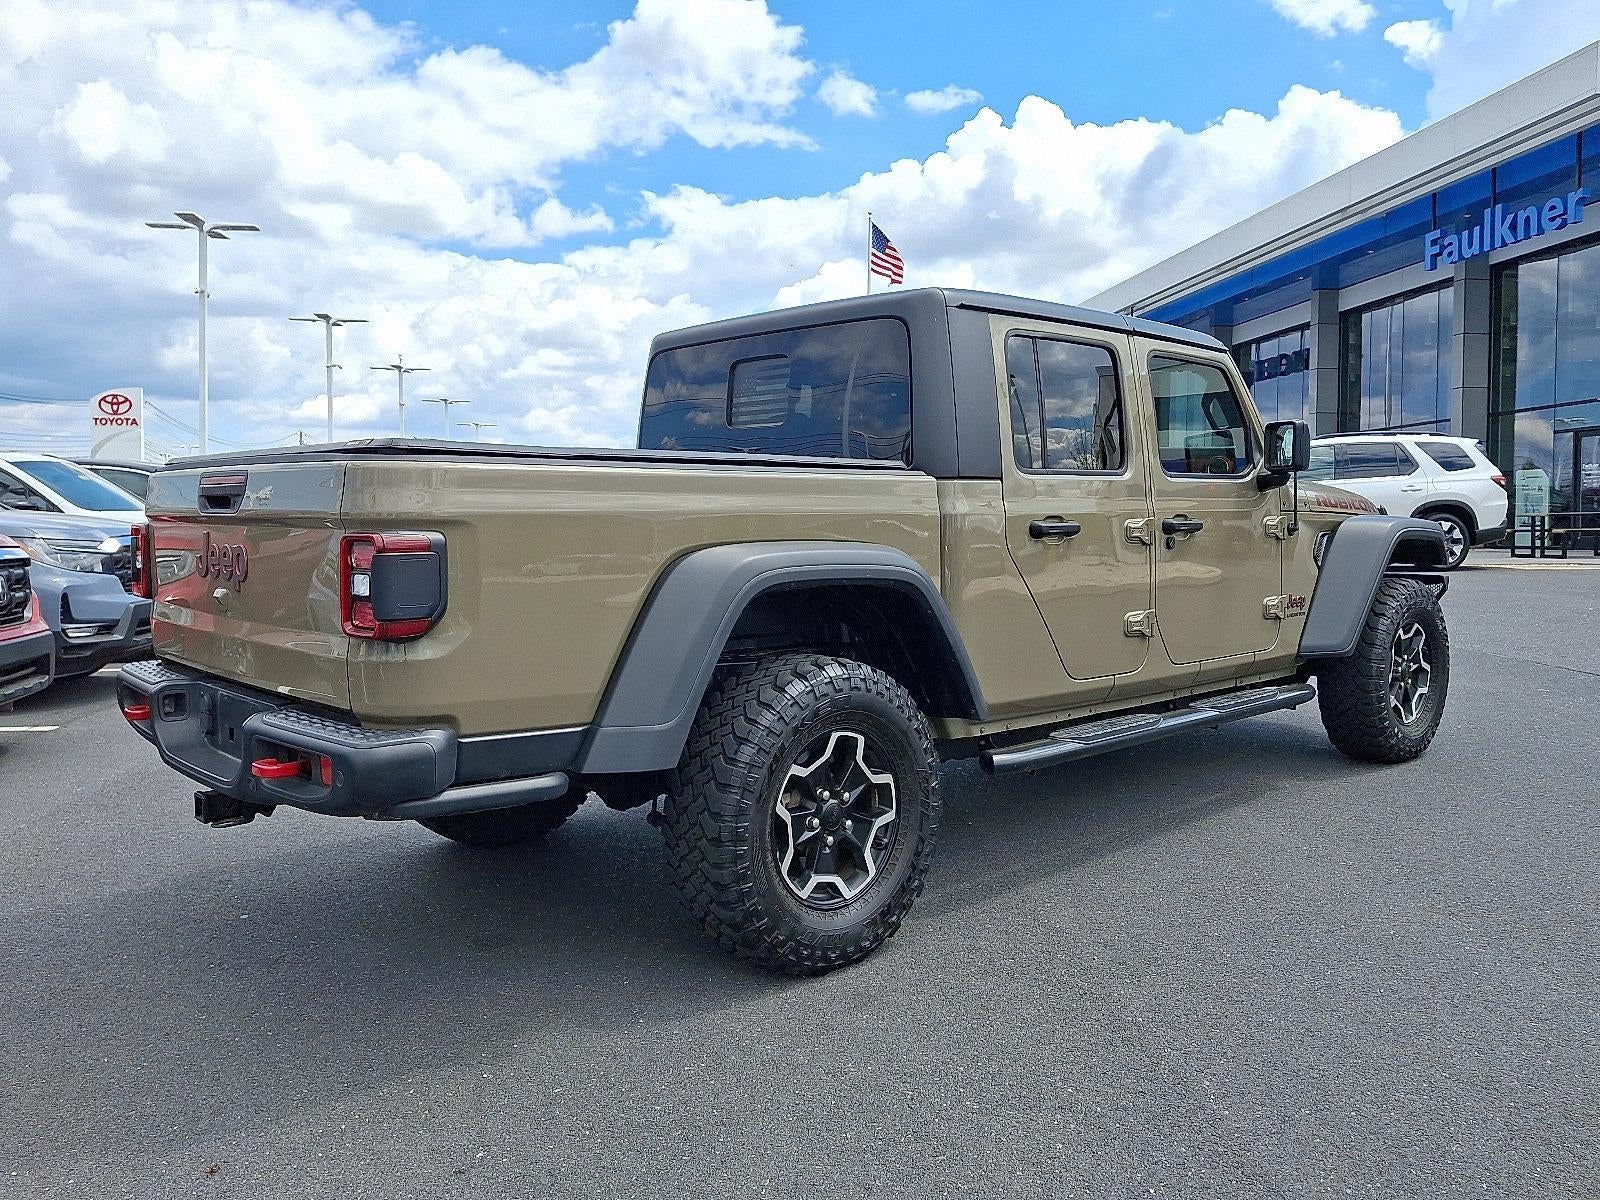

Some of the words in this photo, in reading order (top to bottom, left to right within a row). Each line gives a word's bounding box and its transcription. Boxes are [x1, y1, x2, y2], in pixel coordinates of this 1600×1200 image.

[1424, 187, 1589, 271] Faulkner
[93, 417, 139, 427] TOYOTA
[195, 530, 249, 593] Jeep
[1286, 593, 1306, 611] Jeep
